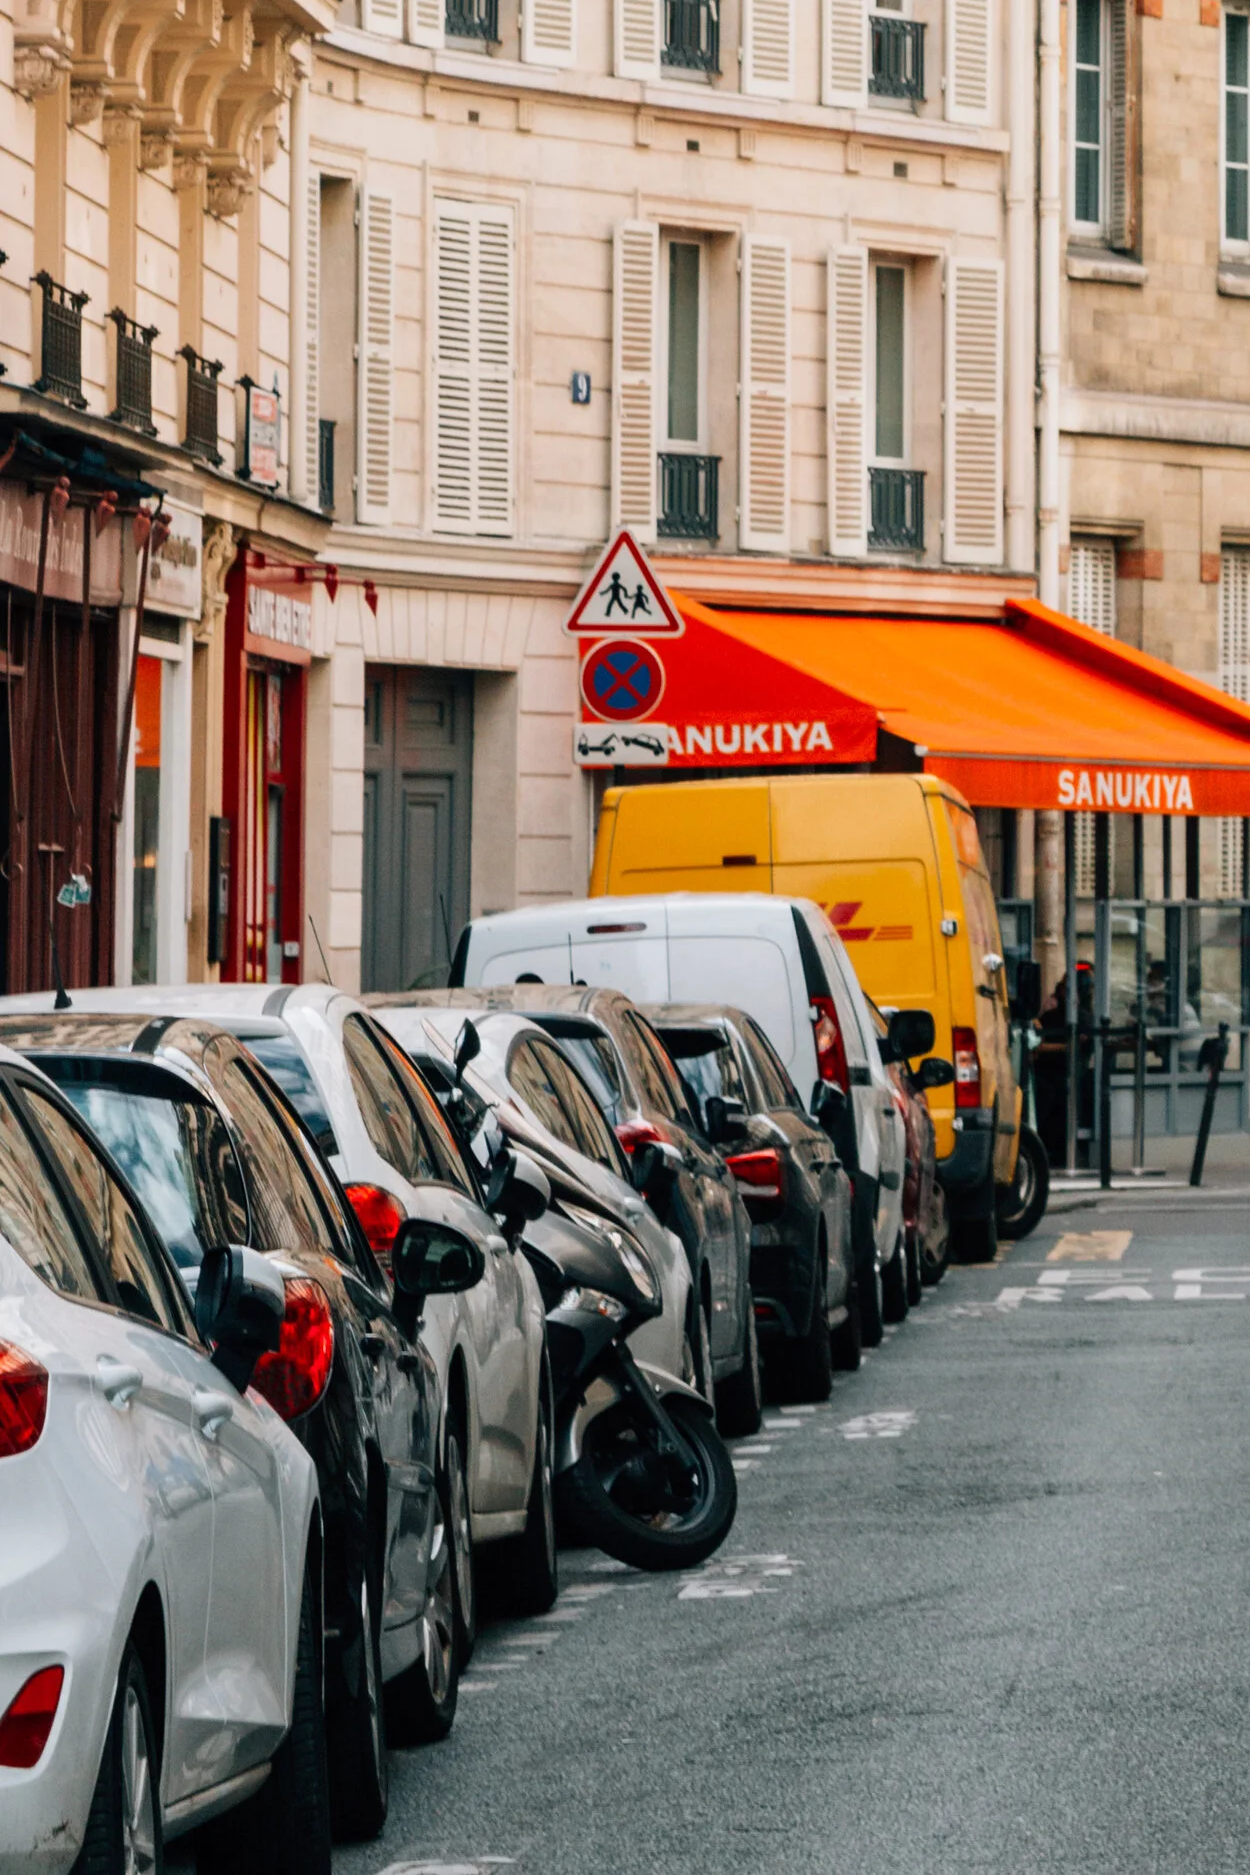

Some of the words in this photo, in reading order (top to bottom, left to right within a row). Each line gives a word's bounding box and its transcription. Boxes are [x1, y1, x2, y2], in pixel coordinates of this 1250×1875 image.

[577, 374, 587, 402] 9
[667, 720, 834, 755] ANUKIYA
[1057, 768, 1194, 811] SANUKIYA
